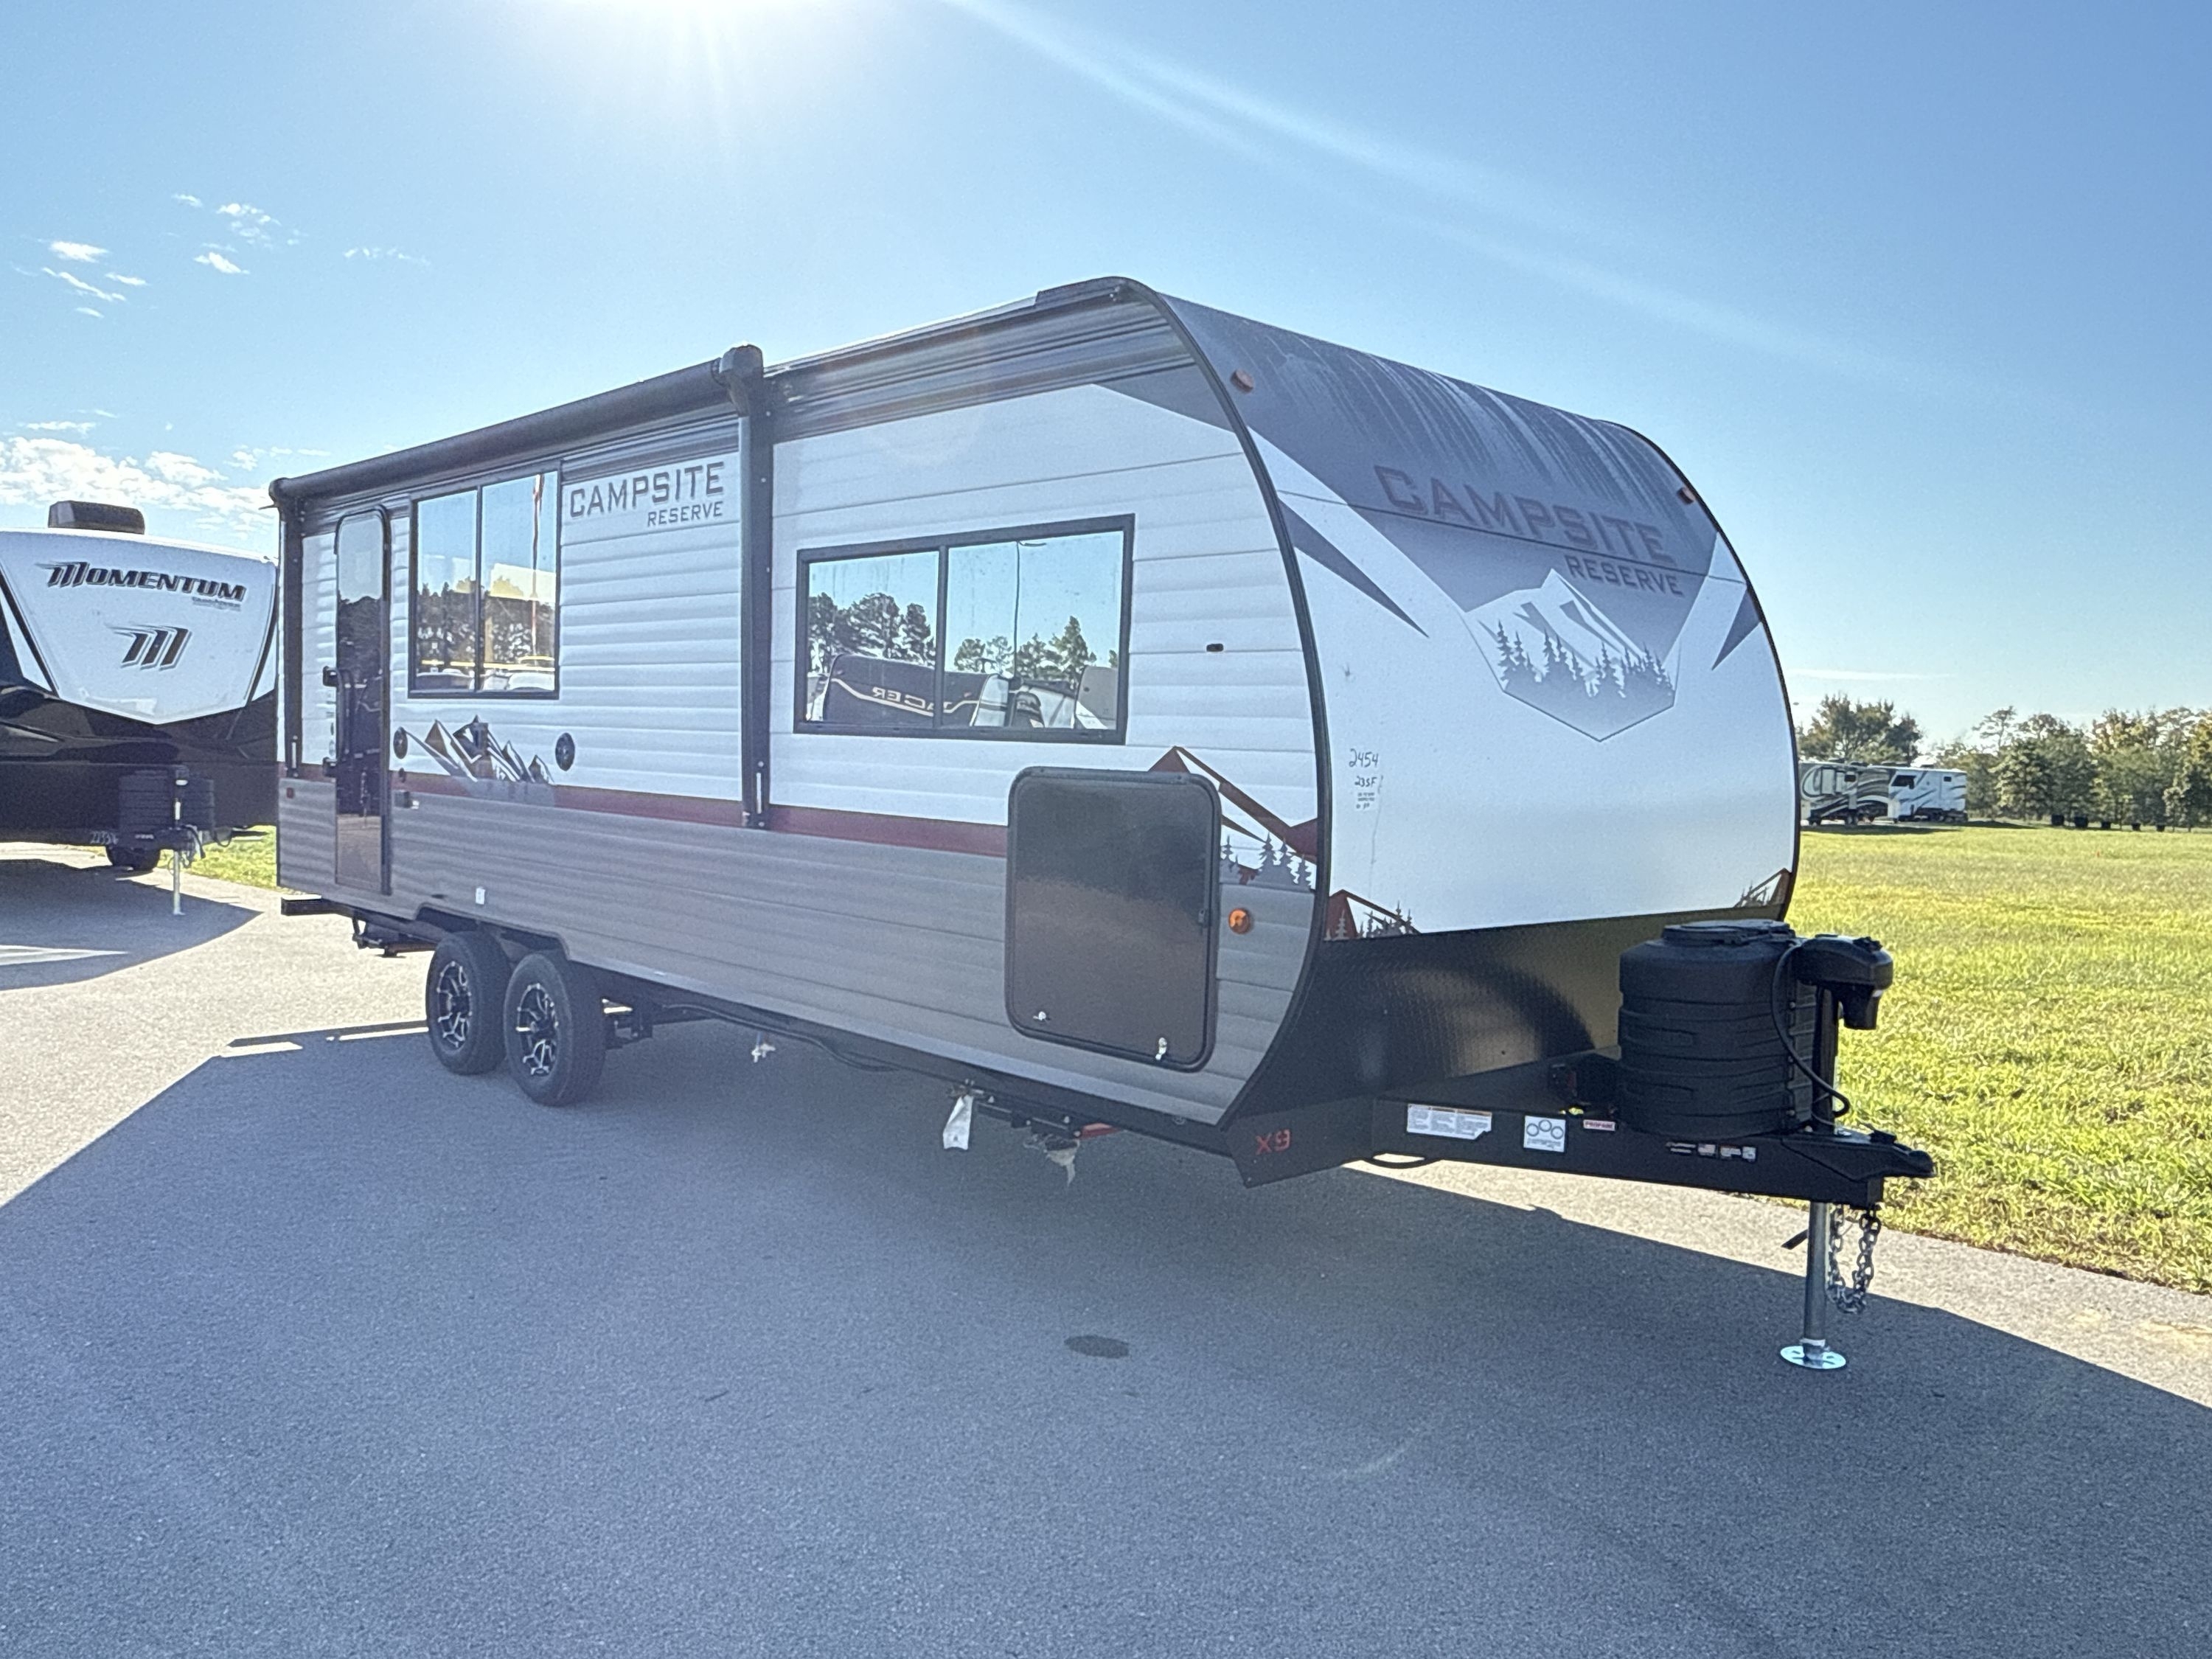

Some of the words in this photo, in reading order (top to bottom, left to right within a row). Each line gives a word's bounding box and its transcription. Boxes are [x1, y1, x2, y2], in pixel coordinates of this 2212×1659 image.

[570, 462, 725, 518] CAMPSITE
[647, 501, 723, 527] RESERVE
[1374, 465, 1676, 563] CAMPSITE
[37, 561, 247, 602] MOMENTUM
[1564, 554, 1684, 597] RESERVE
[1349, 748, 1379, 768] 2454
